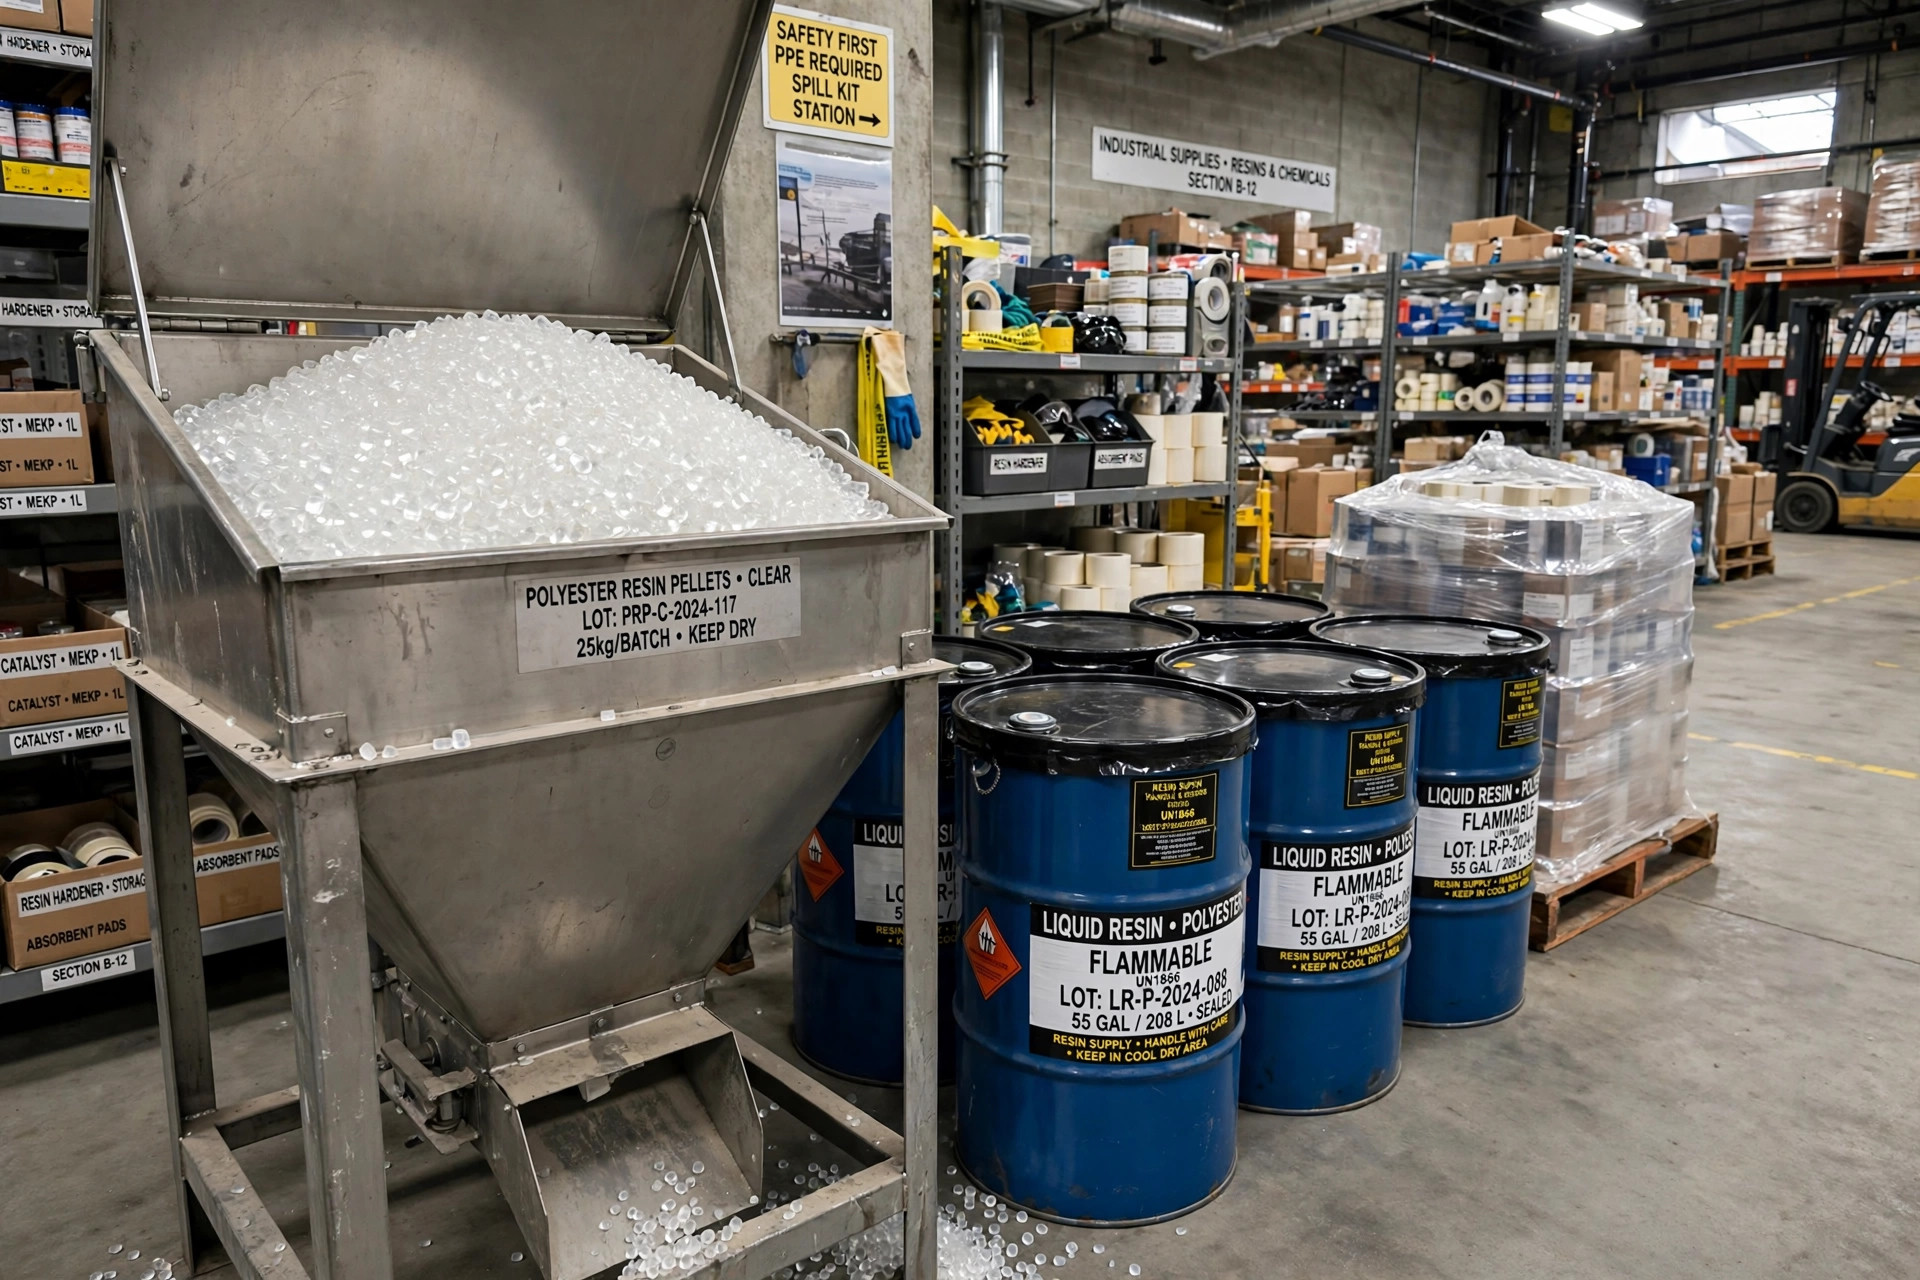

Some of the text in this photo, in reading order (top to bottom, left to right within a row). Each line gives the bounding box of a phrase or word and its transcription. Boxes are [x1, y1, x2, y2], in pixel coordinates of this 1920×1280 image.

[60, 43, 91, 58] STORA
[777, 20, 877, 57] SAFETY FIRST
[775, 44, 882, 82] PPE REQUIRED
[792, 74, 860, 102] SPILL KIT
[793, 99, 855, 126] STATION
[1100, 135, 1330, 187] INDUSTRIAL SUPPLIES RESINS & CHEMICALS
[1188, 171, 1257, 196] SECTION B-12
[1, 298, 53, 317] HARDENER
[25, 418, 55, 432] MEKP
[66, 417, 78, 431] 1L
[24, 459, 54, 471] MEKP
[66, 458, 79, 470] 1L
[26, 495, 58, 508] MEKP
[70, 494, 83, 506] 1L
[526, 564, 791, 608] POLYESTER RESIN PELLETS CLEAR
[583, 595, 737, 630] LOT: PRP-C-2024-117
[577, 617, 757, 659] 25kg/BATCH KEEP DRY
[1, 646, 123, 673] CATALYST MEKP 1L
[8, 688, 124, 712] CATALYST MEKP 1L
[14, 722, 126, 749] CATALYST MEKP 1L
[1428, 787, 1474, 805] LIQUID
[1478, 784, 1512, 805] RESIN
[1462, 800, 1534, 831] FLAMMABLE
[863, 823, 903, 844] LIQUI
[196, 845, 279, 873] ABSORBENT PADS
[1273, 846, 1326, 868] LIQUID
[1331, 843, 1372, 867] RESIN
[1444, 841, 1475, 858] LOT:
[1314, 861, 1404, 897] FLAMMABLE
[1450, 861, 1465, 874] 55
[1470, 860, 1493, 874] GAL
[21, 872, 146, 912] RESIN HARDENER STORAG
[1434, 880, 1460, 888] RESIN
[1043, 890, 1243, 940] LIQUID RESIN POLYESTER
[1292, 908, 1329, 928] LOT:
[26, 918, 127, 952] ABSORBENT PADS
[1300, 932, 1317, 945] 55
[1322, 930, 1349, 945] GAL
[1353, 928, 1358, 943] /
[1361, 923, 1380, 941] 208
[52, 954, 128, 982] SECTION B-12
[1089, 938, 1213, 975] FLAMMABLE
[1280, 951, 1309, 961] RESIN
[1312, 951, 1347, 961] SUPPLY
[1301, 962, 1326, 972] KEEP
[1329, 961, 1338, 971] IN
[1341, 958, 1366, 970] COOL
[1060, 968, 1227, 1011] LOT: LR-P-2024-088
[1071, 988, 1232, 1032] 55 GAL / 208 L SEALED
[1053, 1014, 1229, 1050] RESIN SUPPLY HANDLE WITH CARE
[1076, 1039, 1208, 1063] KEEP IN COOL DRY AREA
